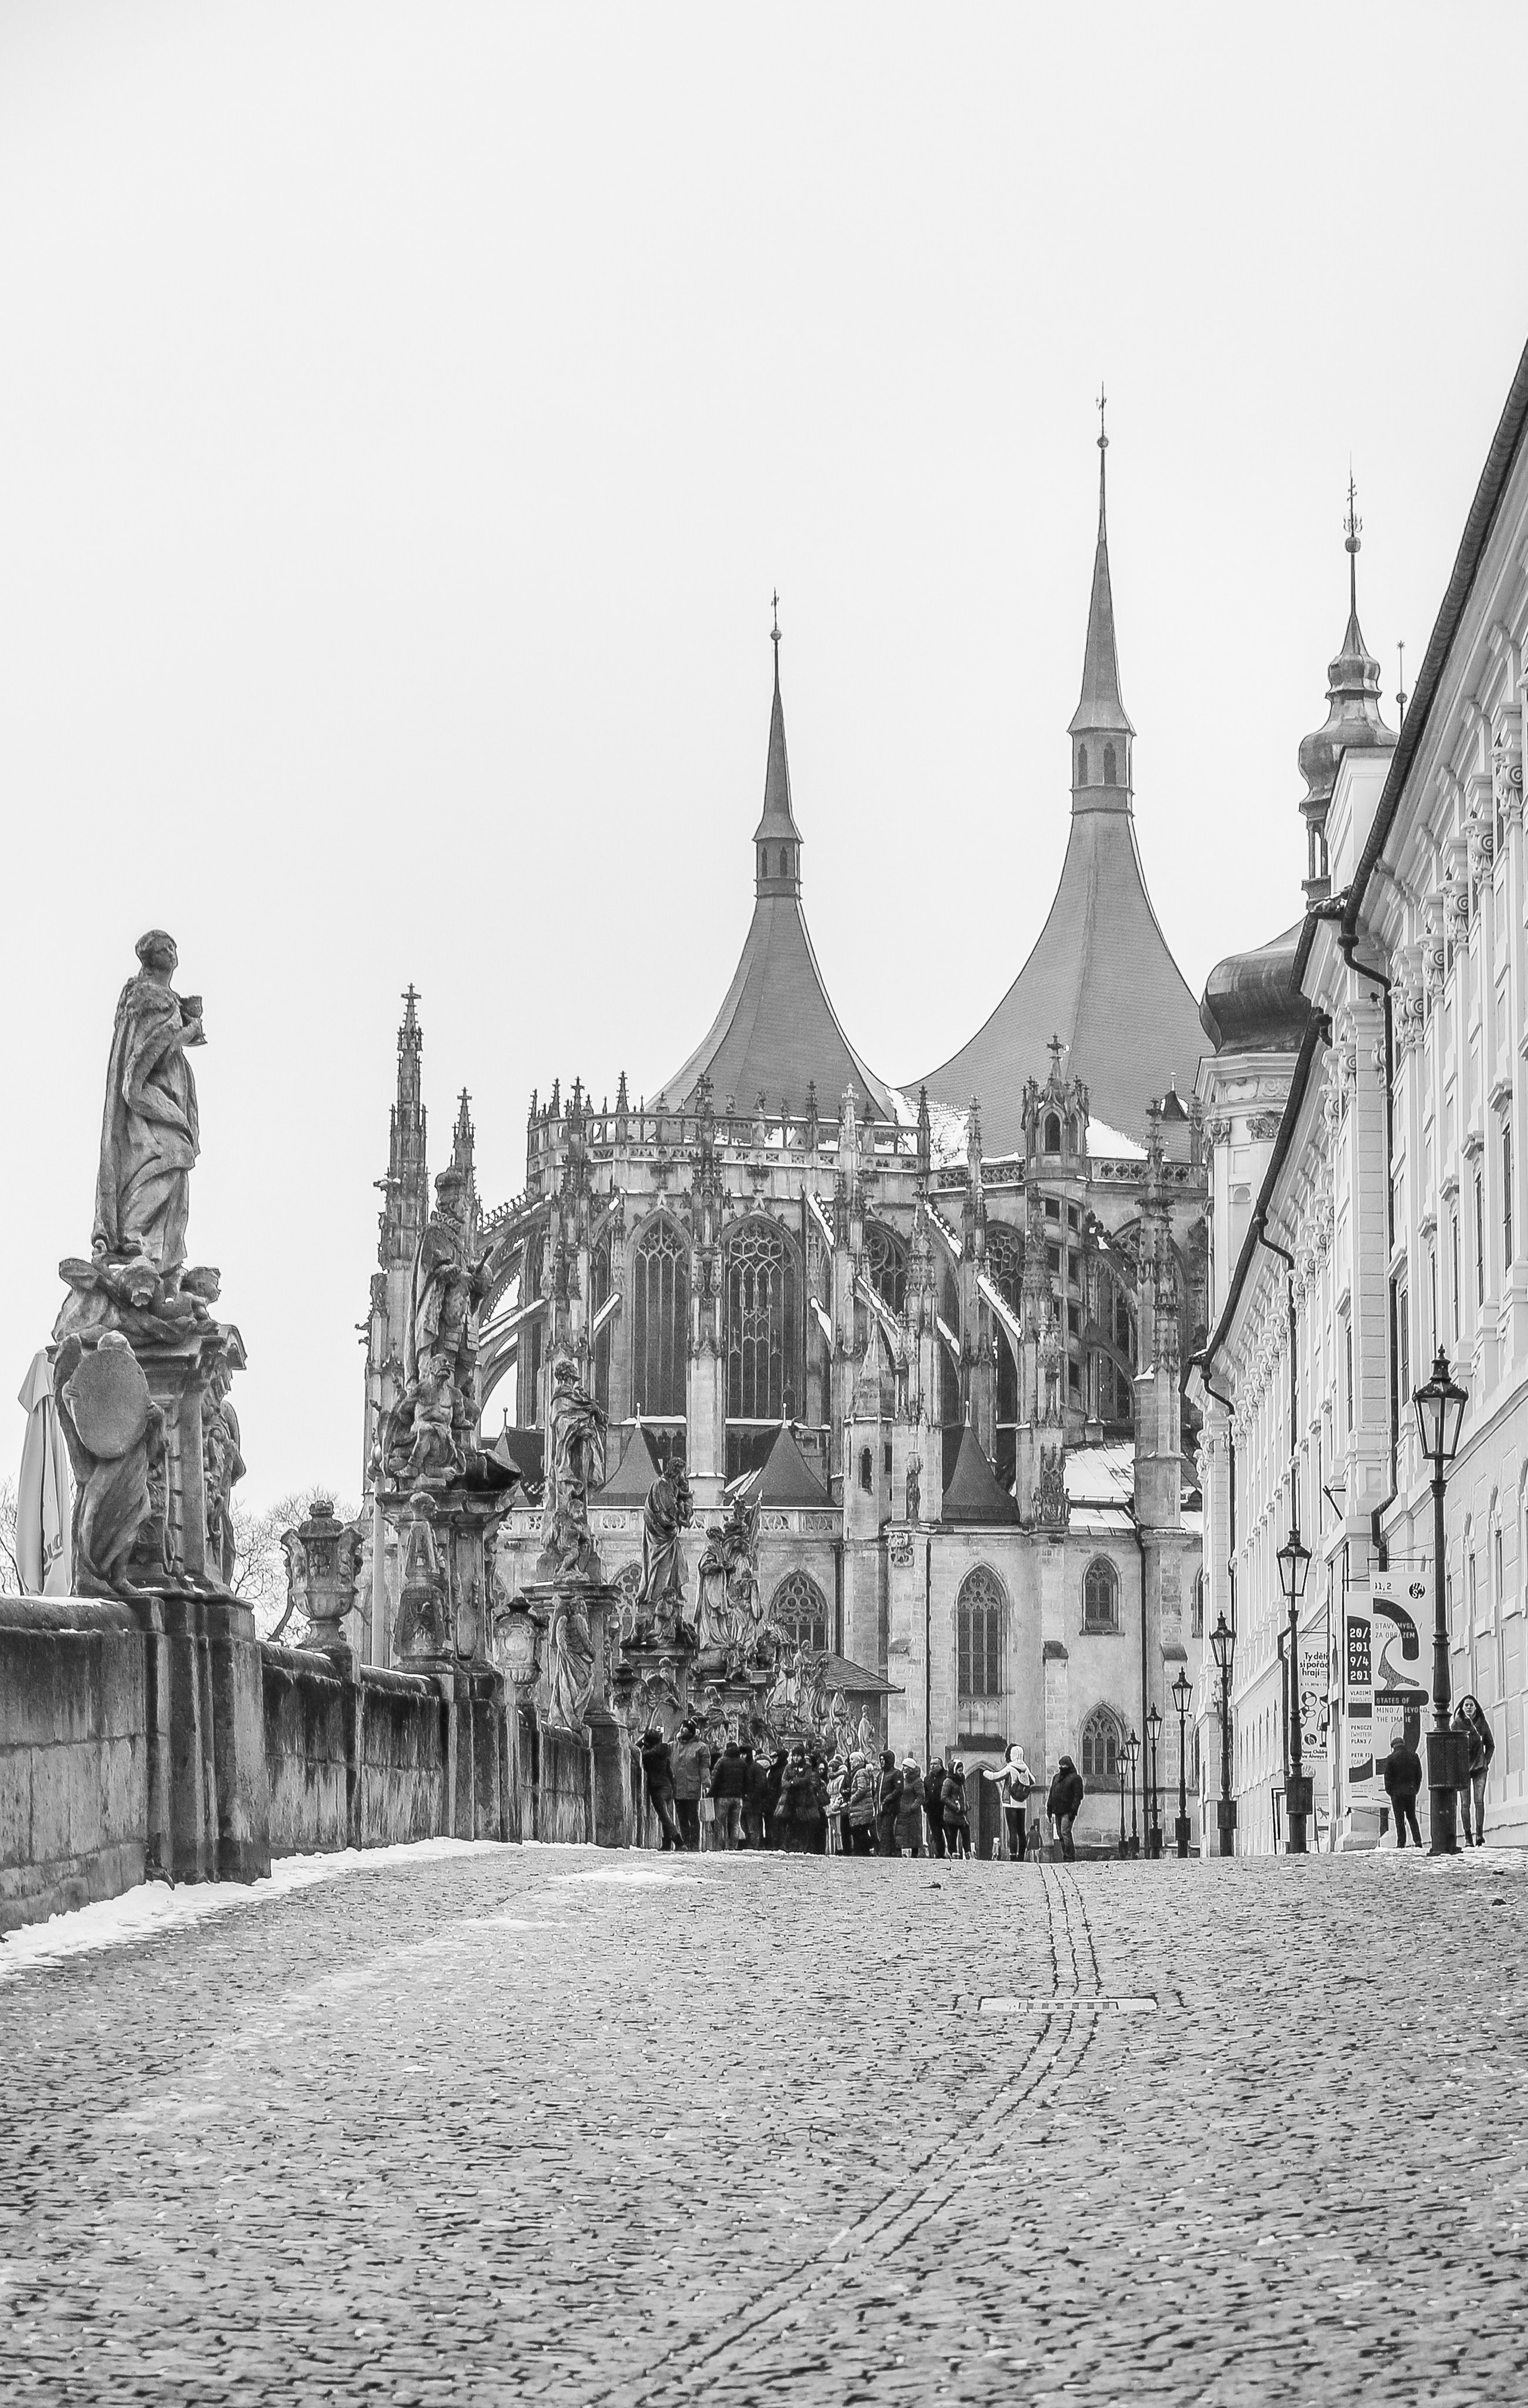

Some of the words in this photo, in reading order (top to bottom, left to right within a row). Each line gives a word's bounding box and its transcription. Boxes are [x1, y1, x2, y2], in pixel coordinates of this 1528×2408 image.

[1350, 1627, 1371, 1639] 20/
[1350, 1642, 1371, 1652] 201
[1304, 1652, 1313, 1662] Ty
[1350, 1655, 1369, 1667] 9/4
[1300, 1660, 1305, 1668] si
[1302, 1667, 1319, 1678] hrají
[1350, 1670, 1372, 1681] 201
